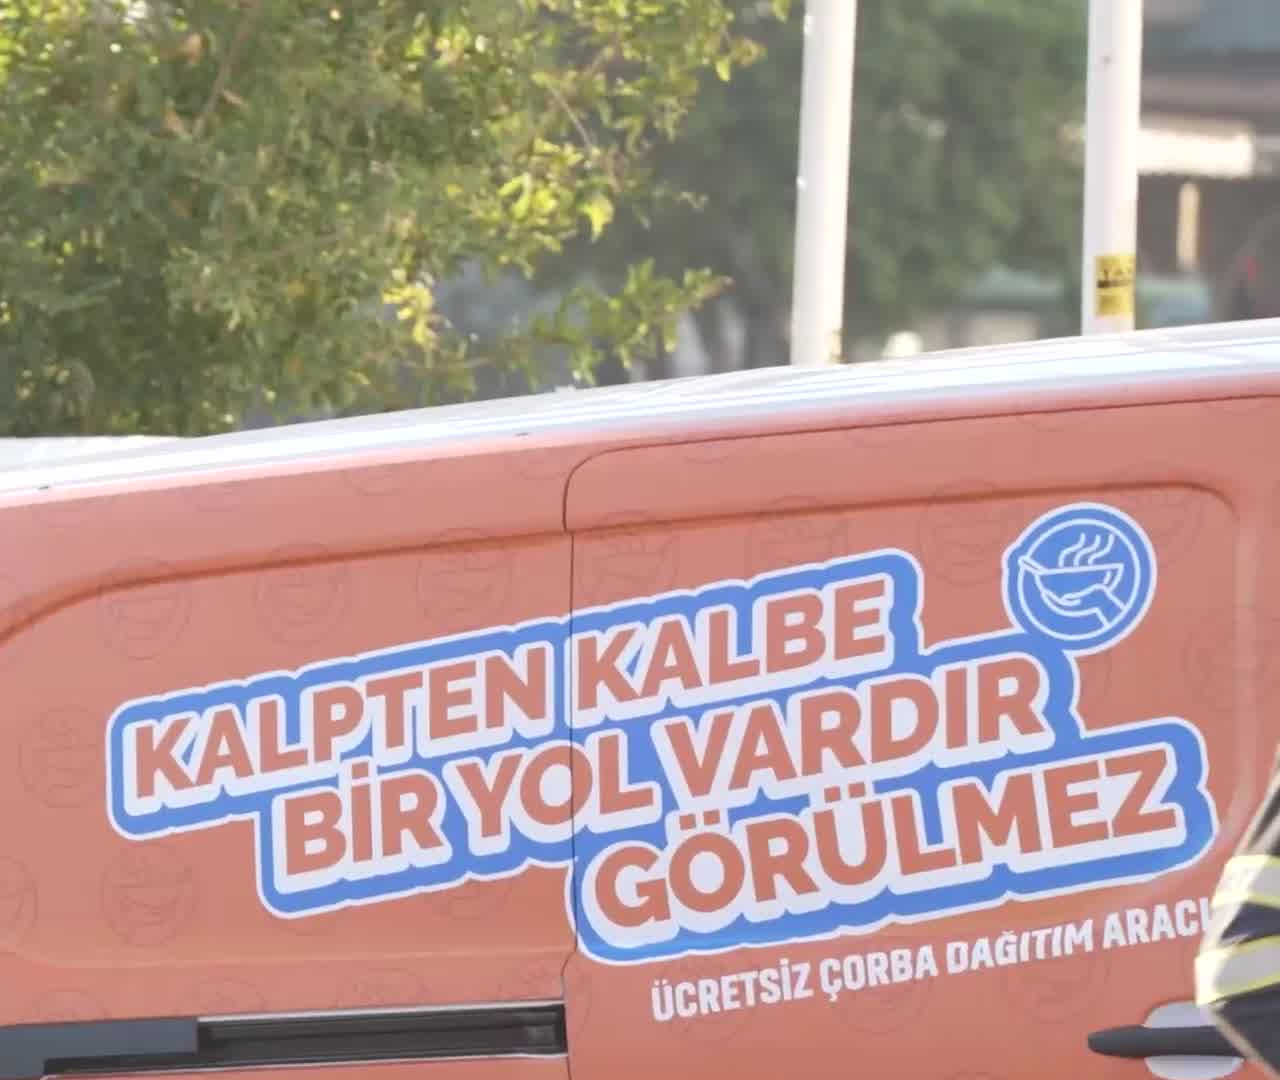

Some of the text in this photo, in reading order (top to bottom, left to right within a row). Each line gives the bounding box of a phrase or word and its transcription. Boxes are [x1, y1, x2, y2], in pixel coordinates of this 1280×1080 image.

[135, 579, 887, 799] KALPTEN KALBE
[285, 656, 1046, 876] BİR YOL VARDIR
[594, 748, 1177, 928] GÖRÜLMEZ
[650, 896, 1209, 1022] ÜCRETSİZ ÇORBA DAĞITIM ARACI
